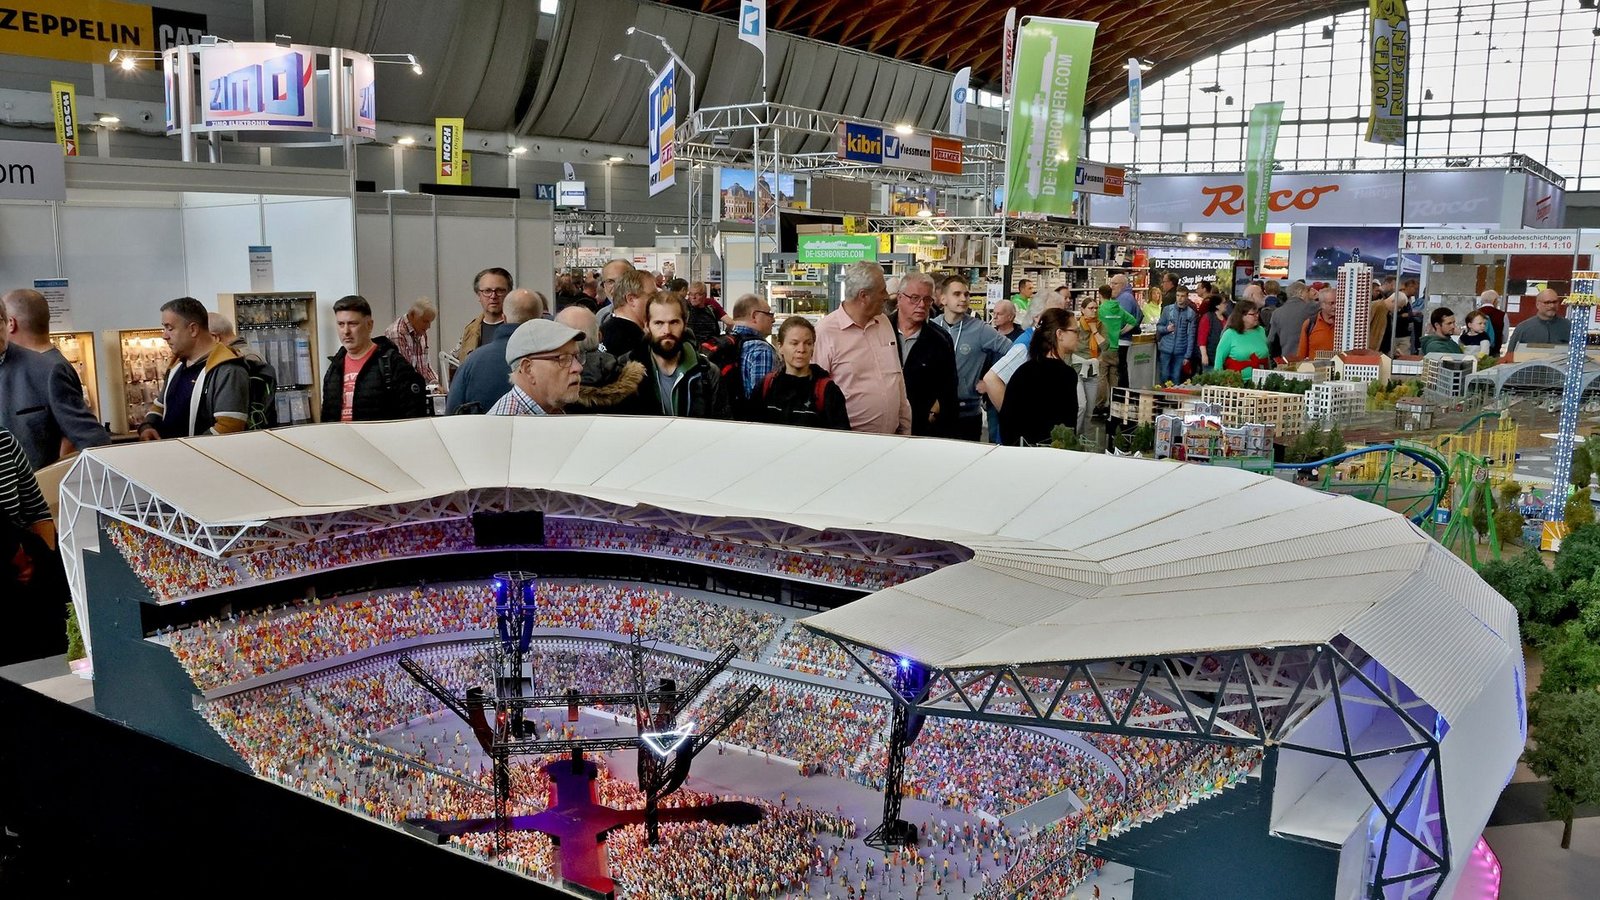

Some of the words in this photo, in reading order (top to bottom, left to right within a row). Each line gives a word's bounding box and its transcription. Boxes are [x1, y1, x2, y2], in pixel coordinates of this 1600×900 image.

[0, 8, 140, 46] ZEPPELIN
[1373, 35, 1389, 108] JOKER
[1390, 29, 1407, 116] RUEGEN
[1042, 54, 1072, 196] DE-ISENBONER.COM
[443, 127, 451, 160] NOCH
[847, 133, 880, 154] kibri
[1201, 184, 1340, 217] Rco
[805, 250, 864, 258] DE-ISENBONER.COM
[1489, 234, 1571, 242] Gebäudebeschichtungen
[1553, 241, 1572, 249] 1:10
[1155, 260, 1231, 269] DE-ISENBONER.COM
